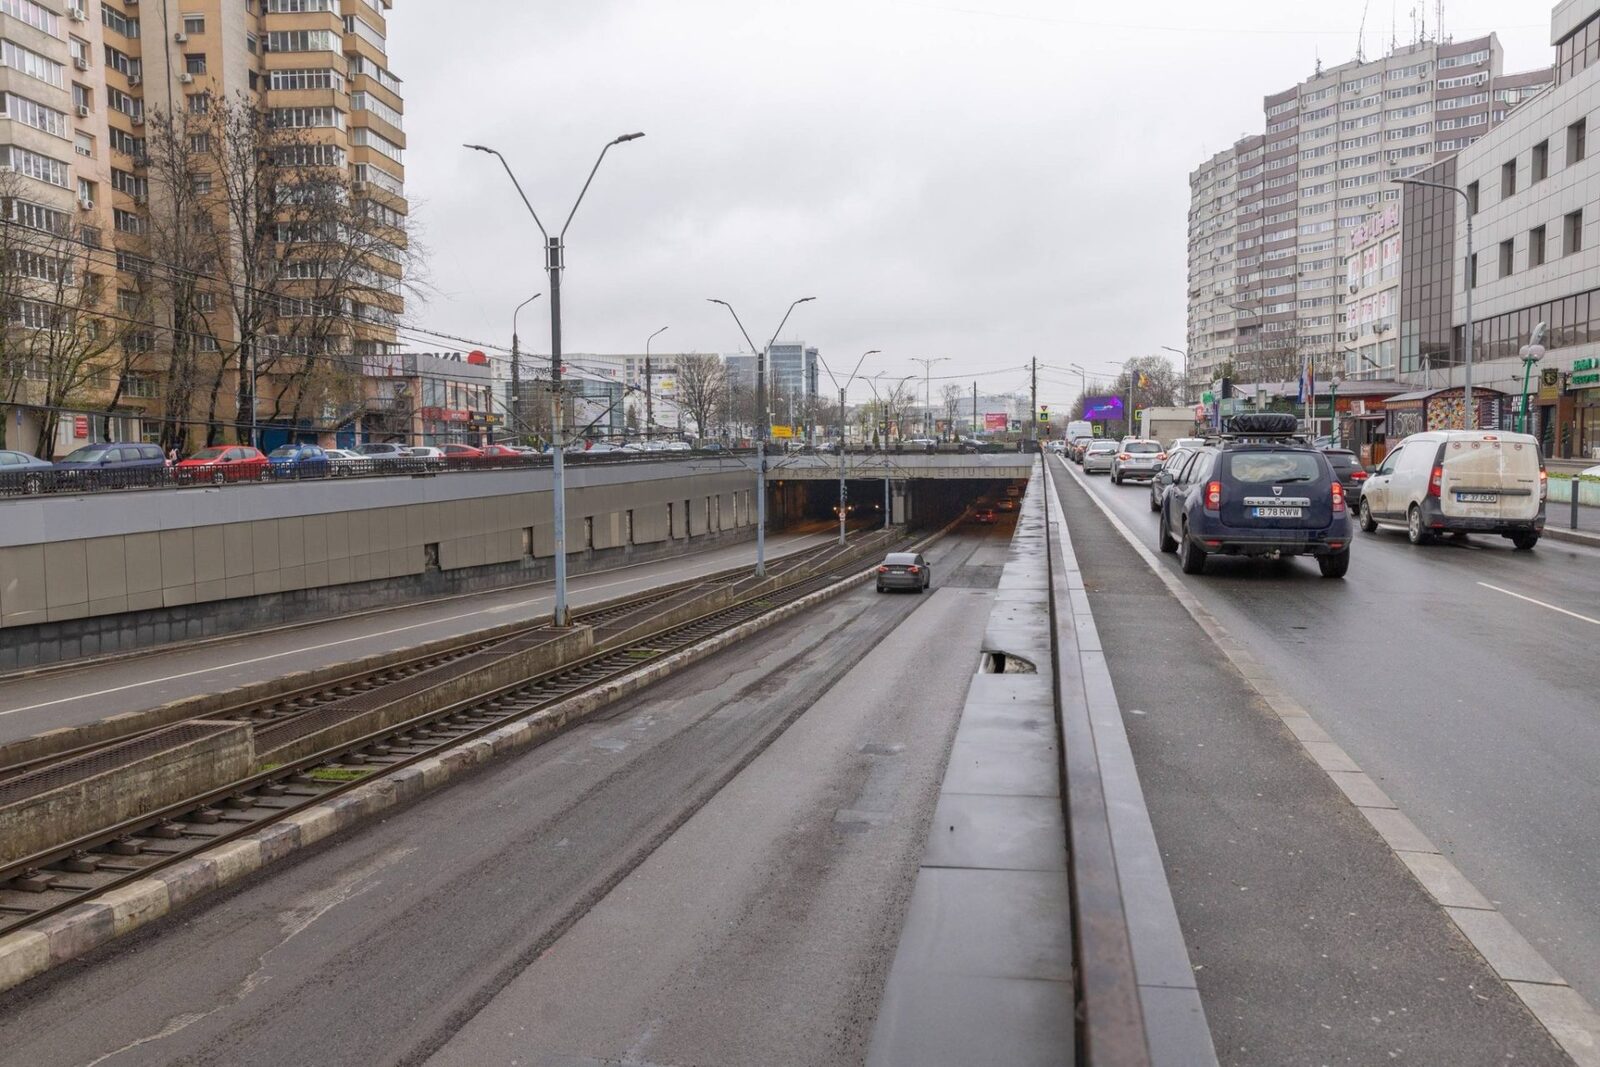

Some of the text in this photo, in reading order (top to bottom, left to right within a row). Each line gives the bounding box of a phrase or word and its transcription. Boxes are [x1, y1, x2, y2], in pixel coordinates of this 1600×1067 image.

[1259, 508, 1300, 516] B 78 RWW
